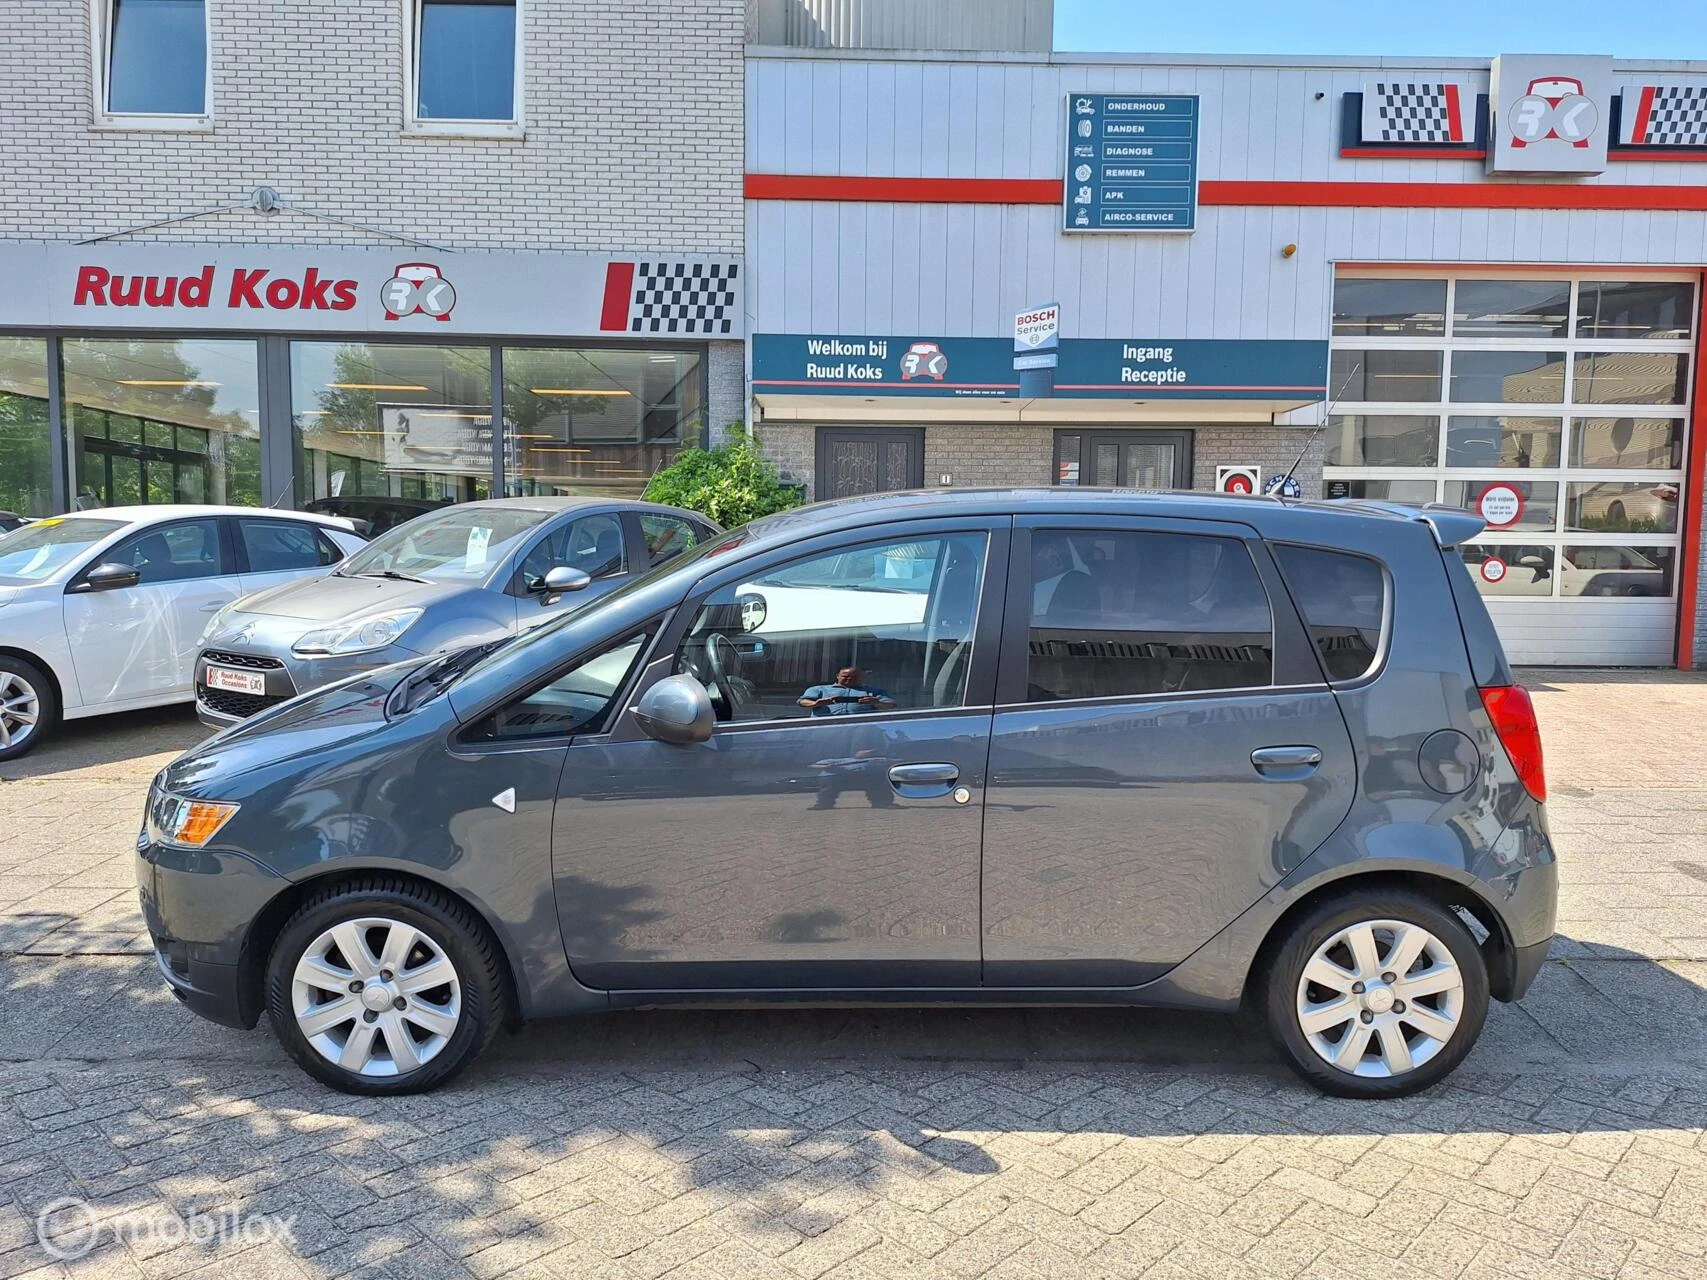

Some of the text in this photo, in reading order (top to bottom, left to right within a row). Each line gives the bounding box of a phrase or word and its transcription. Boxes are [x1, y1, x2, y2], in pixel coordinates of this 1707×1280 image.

[1107, 102, 1166, 111] ONDERHOUD
[1107, 125, 1145, 133] BANDEN
[1106, 147, 1154, 155] DIAGNOSE
[1105, 169, 1146, 177] REMMEN
[1104, 191, 1124, 200] APK
[1104, 213, 1174, 221] AIRCO-SERVICE
[73, 265, 359, 311] Ruud Koks
[1017, 310, 1056, 326] BOSCH
[1017, 322, 1055, 335] Service
[807, 340, 888, 359] Welkom bij
[1123, 343, 1173, 363] Ingang
[806, 363, 883, 380] Ruud Koks
[1121, 366, 1187, 386] Receptie
